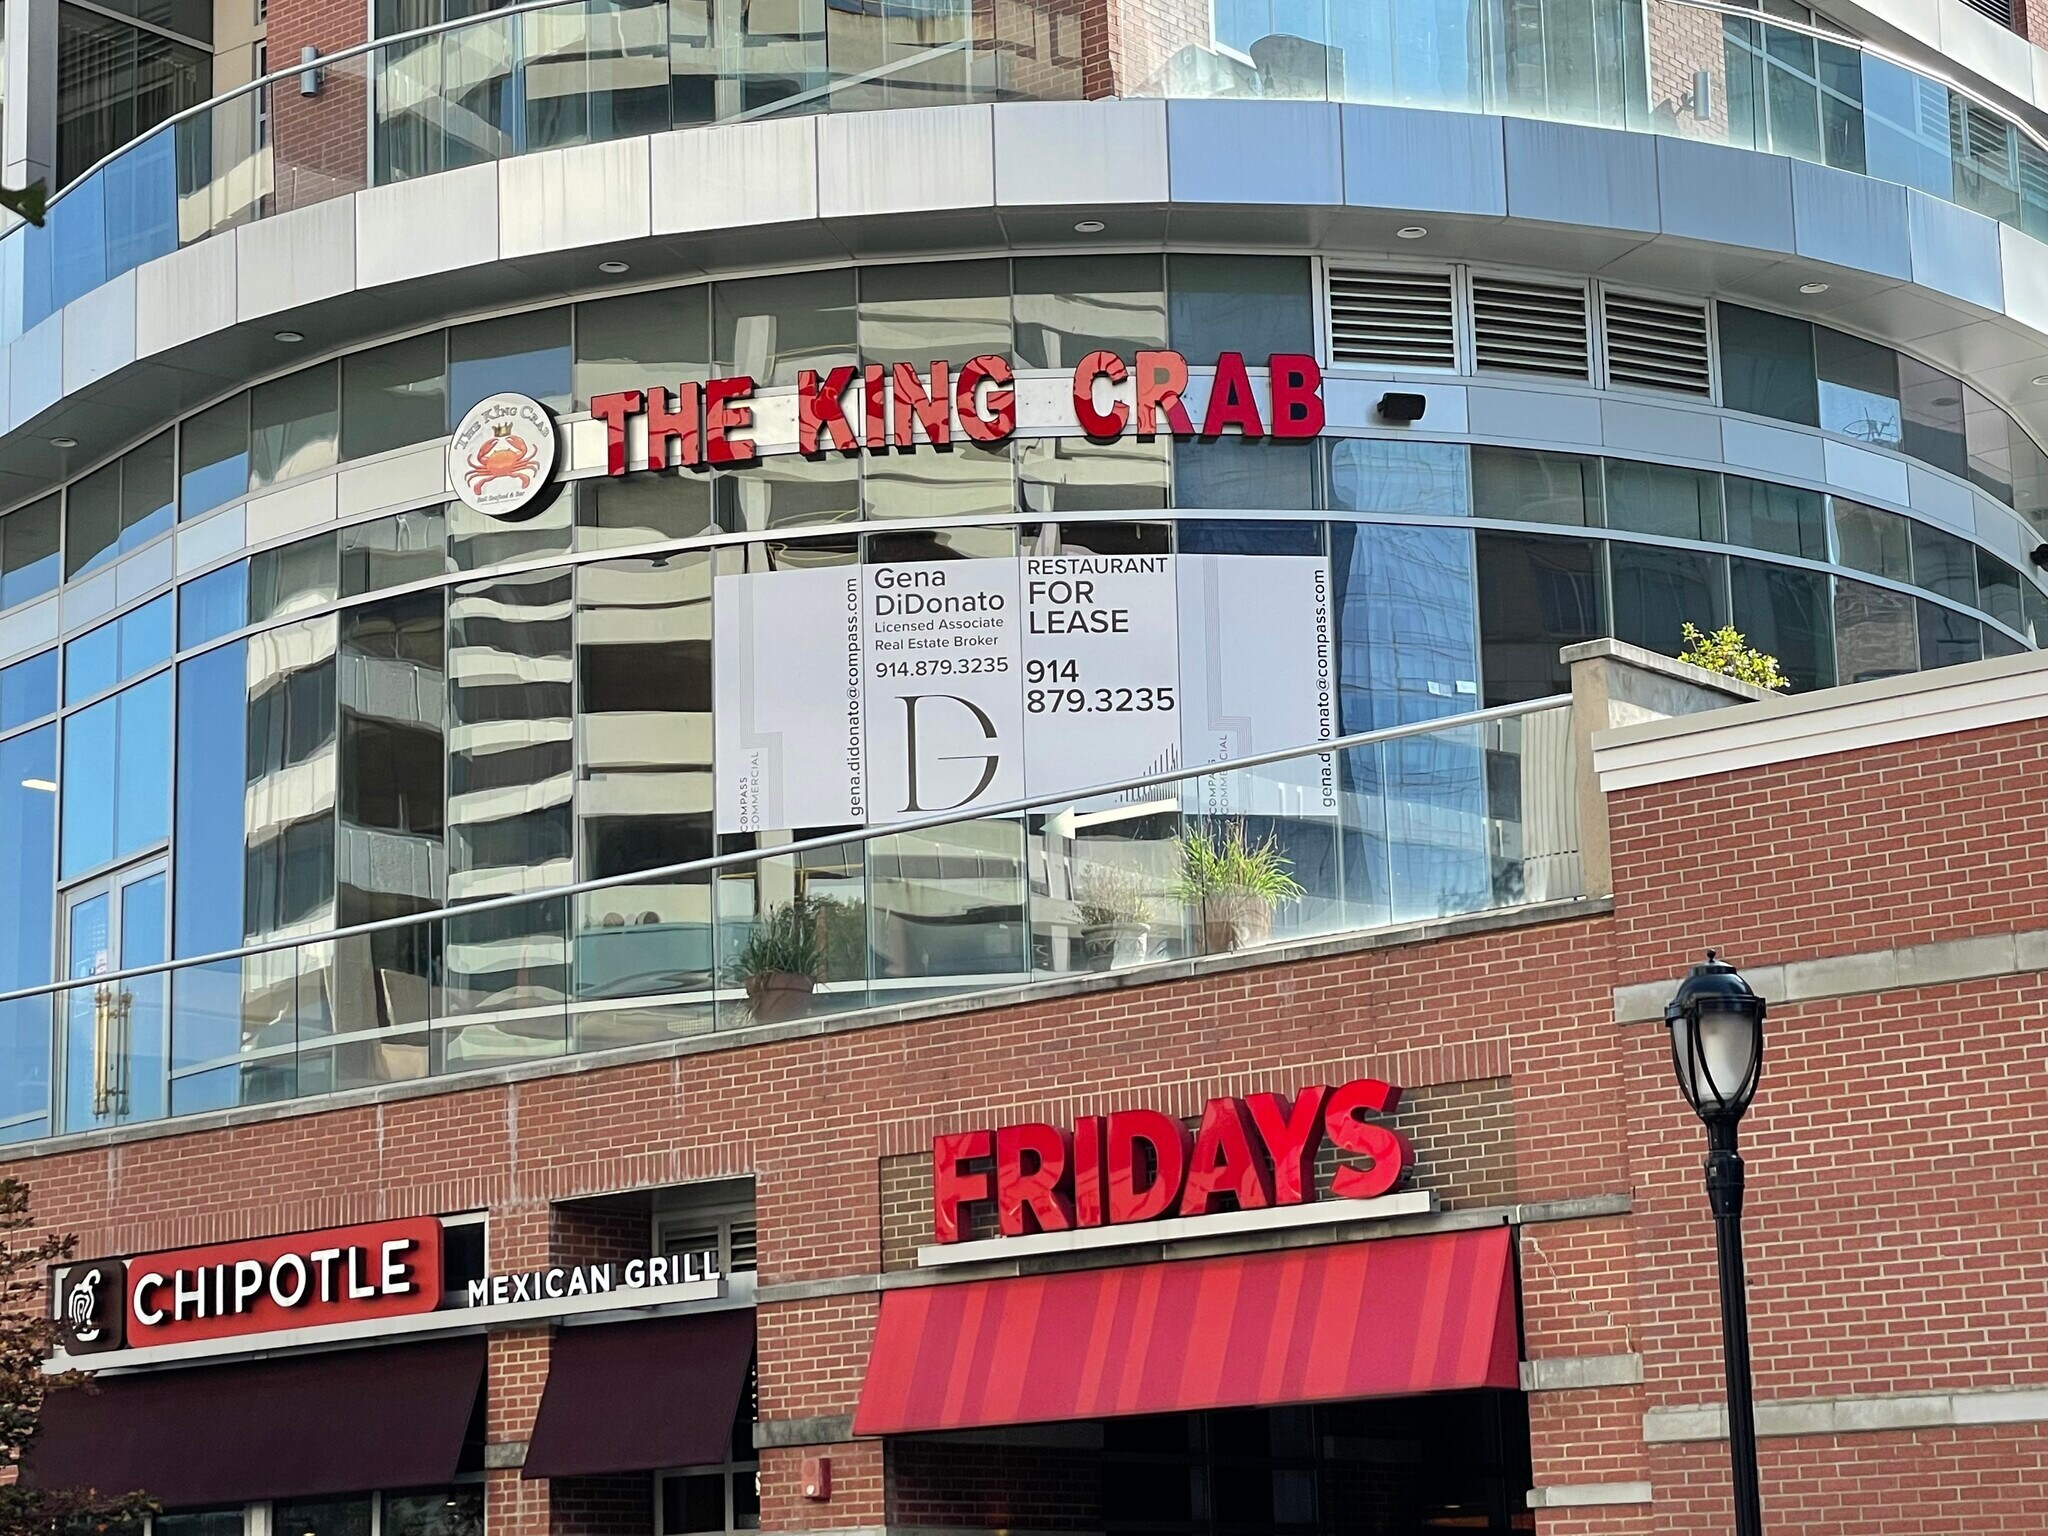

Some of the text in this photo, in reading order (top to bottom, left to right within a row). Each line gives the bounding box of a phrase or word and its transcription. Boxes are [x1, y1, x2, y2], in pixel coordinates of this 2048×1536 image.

[590, 350, 1326, 478] THE KING CRAB
[874, 567, 947, 589] Gena
[1028, 558, 1168, 575] RESTAURANT
[875, 591, 1005, 616] DiDonato
[1029, 580, 1094, 604] FOR
[874, 616, 1004, 633] Licensed Associate
[1030, 609, 1129, 634] LEASE
[875, 635, 999, 651] Real Estate Broker
[875, 656, 1009, 678] 914.879.3235
[1026, 659, 1079, 683] 914
[847, 578, 863, 816] gena.didonato@compass.com
[1027, 687, 1175, 713] 879.3235
[1313, 569, 1336, 808] gena.donato@compass.com
[1219, 734, 1230, 815] COMMECIAL
[739, 776, 749, 833] COMPASS
[750, 751, 760, 832] COMMERCIAL
[933, 1079, 1412, 1244] FRIDAYS
[132, 1238, 412, 1327] CHIPOTLE
[467, 1250, 722, 1308] MEXICAN GRILL
